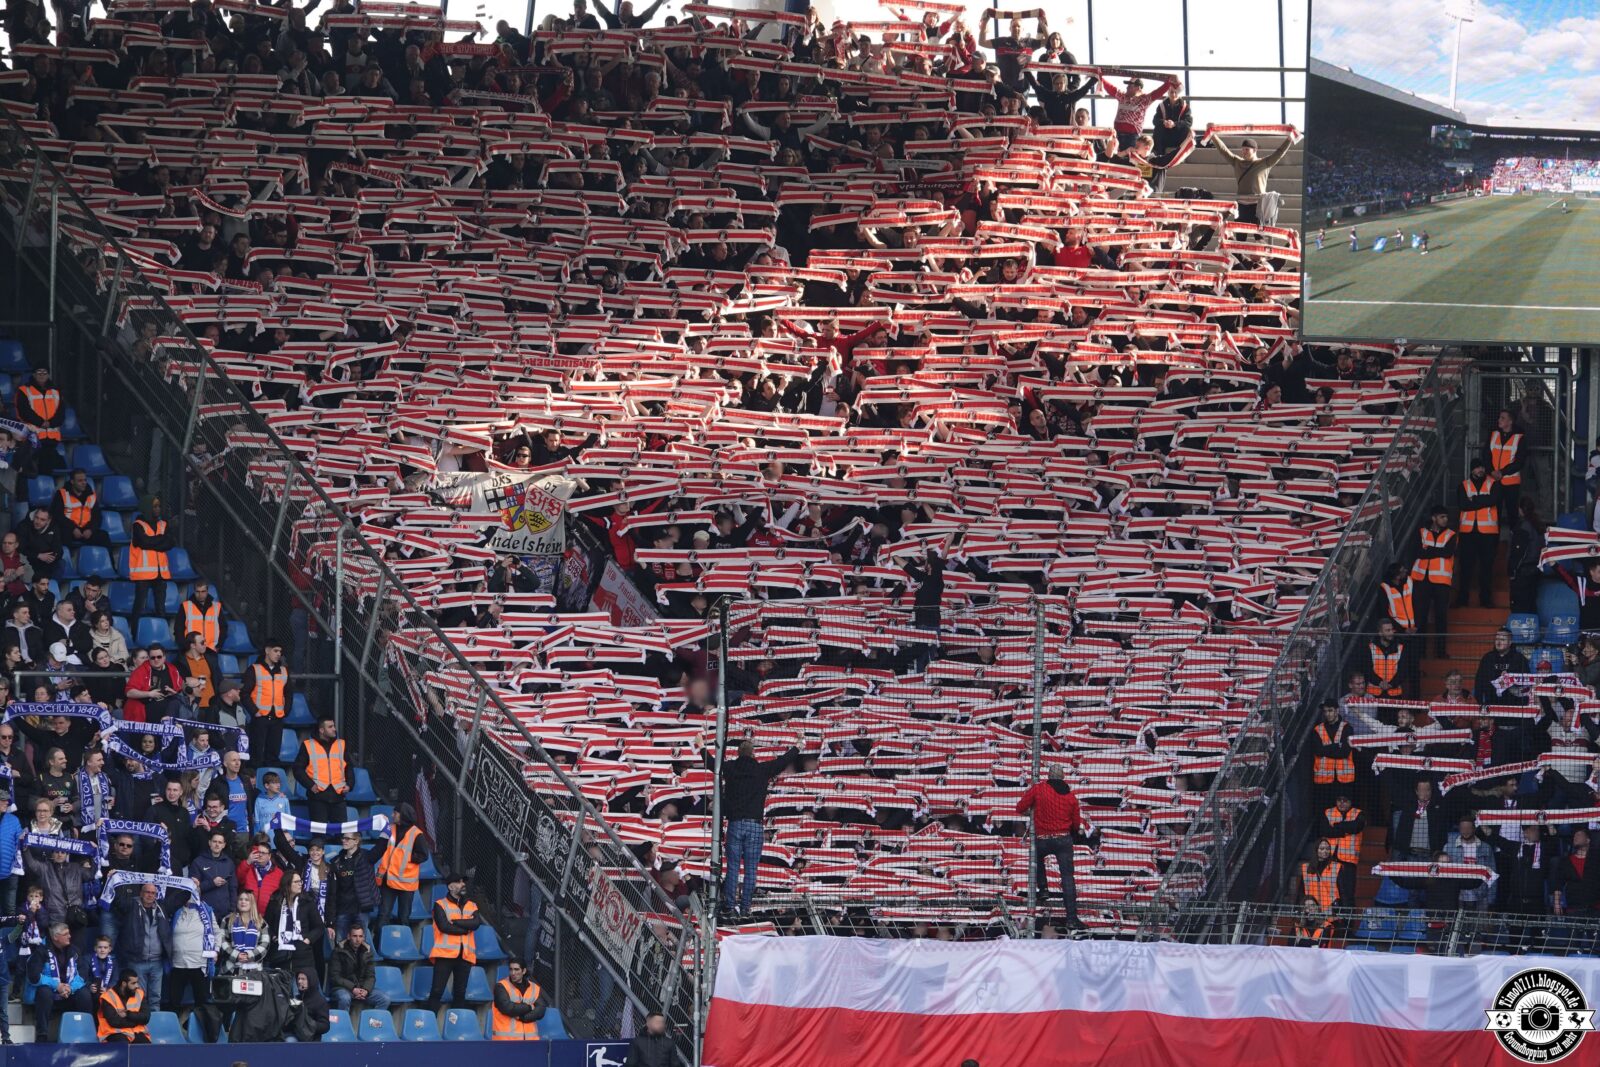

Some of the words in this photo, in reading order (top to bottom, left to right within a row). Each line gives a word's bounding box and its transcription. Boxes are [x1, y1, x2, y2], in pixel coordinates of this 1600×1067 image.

[28, 704, 76, 713] BOCHUM
[78, 705, 99, 716] 1848
[109, 820, 155, 834] BOCHUM
